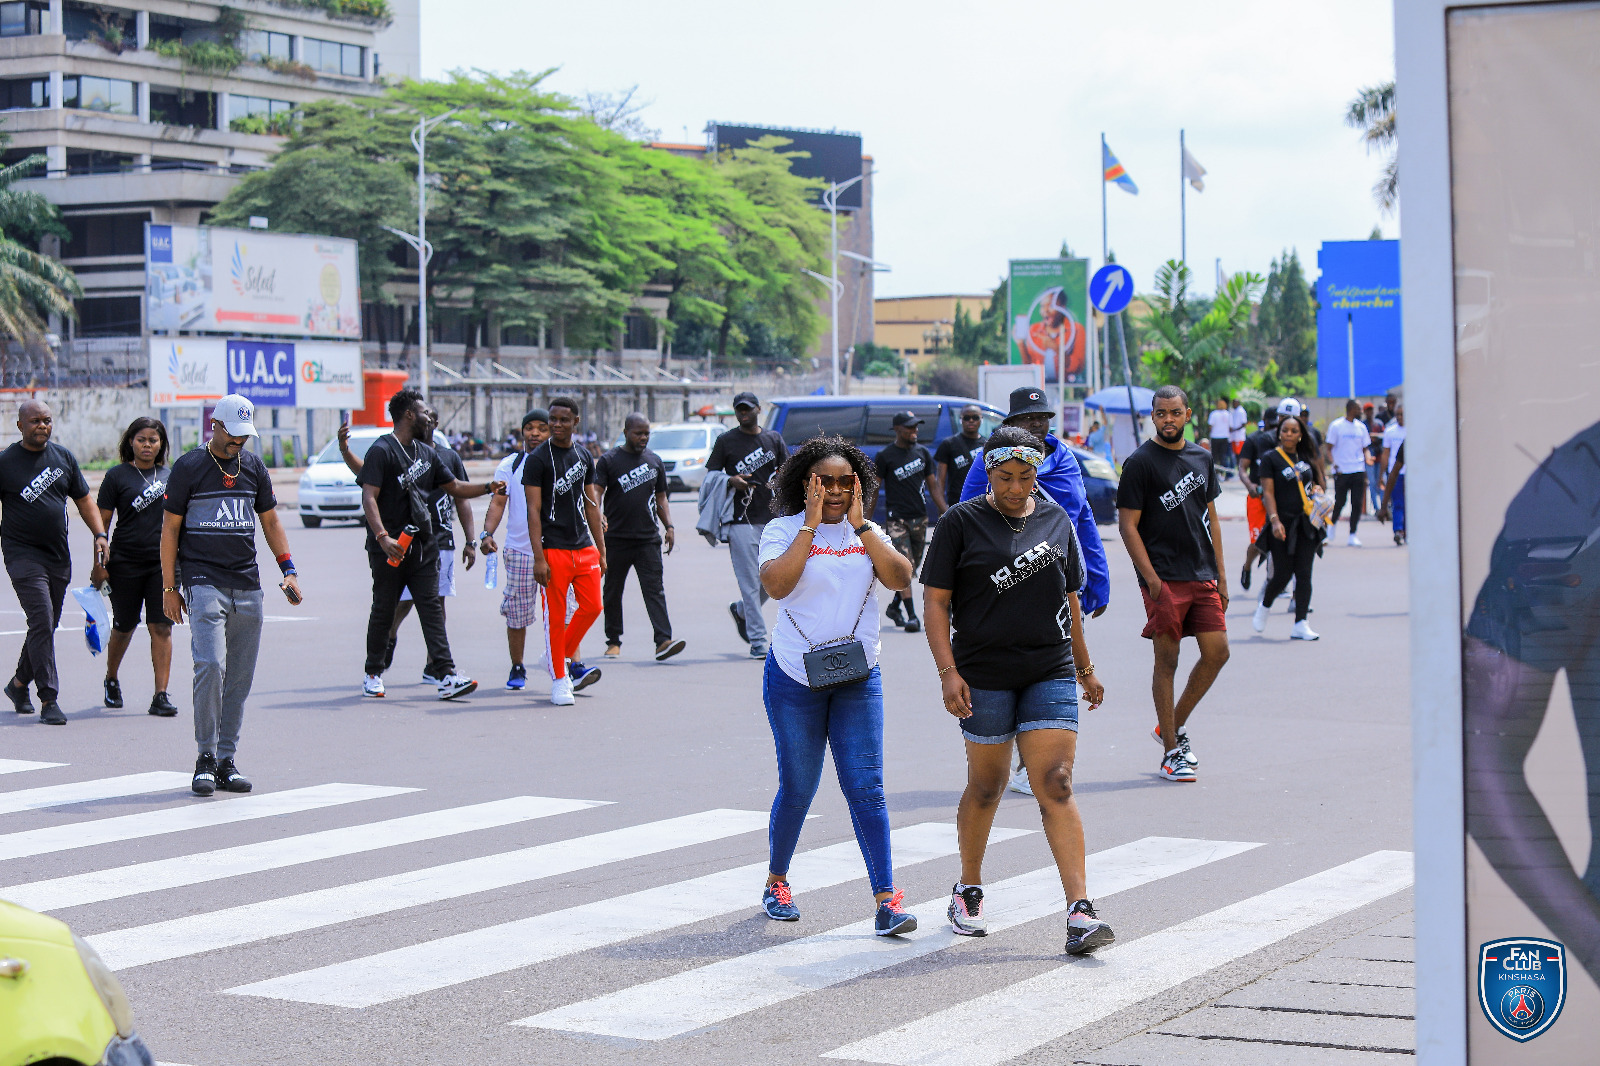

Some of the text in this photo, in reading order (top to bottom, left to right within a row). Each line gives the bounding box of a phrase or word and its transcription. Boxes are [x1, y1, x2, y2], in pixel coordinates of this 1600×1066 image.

[244, 264, 277, 293] Select
[1333, 297, 1394, 308] cha-cha
[180, 361, 209, 385] Select
[229, 348, 294, 385] U.A.C.
[19, 485, 33, 499] ICI
[1159, 489, 1176, 504] ICI
[806, 544, 866, 560] Balenciag
[990, 565, 1012, 585] ICI
[996, 543, 1065, 594] KINSHASA
[817, 667, 862, 682] CHANEL
